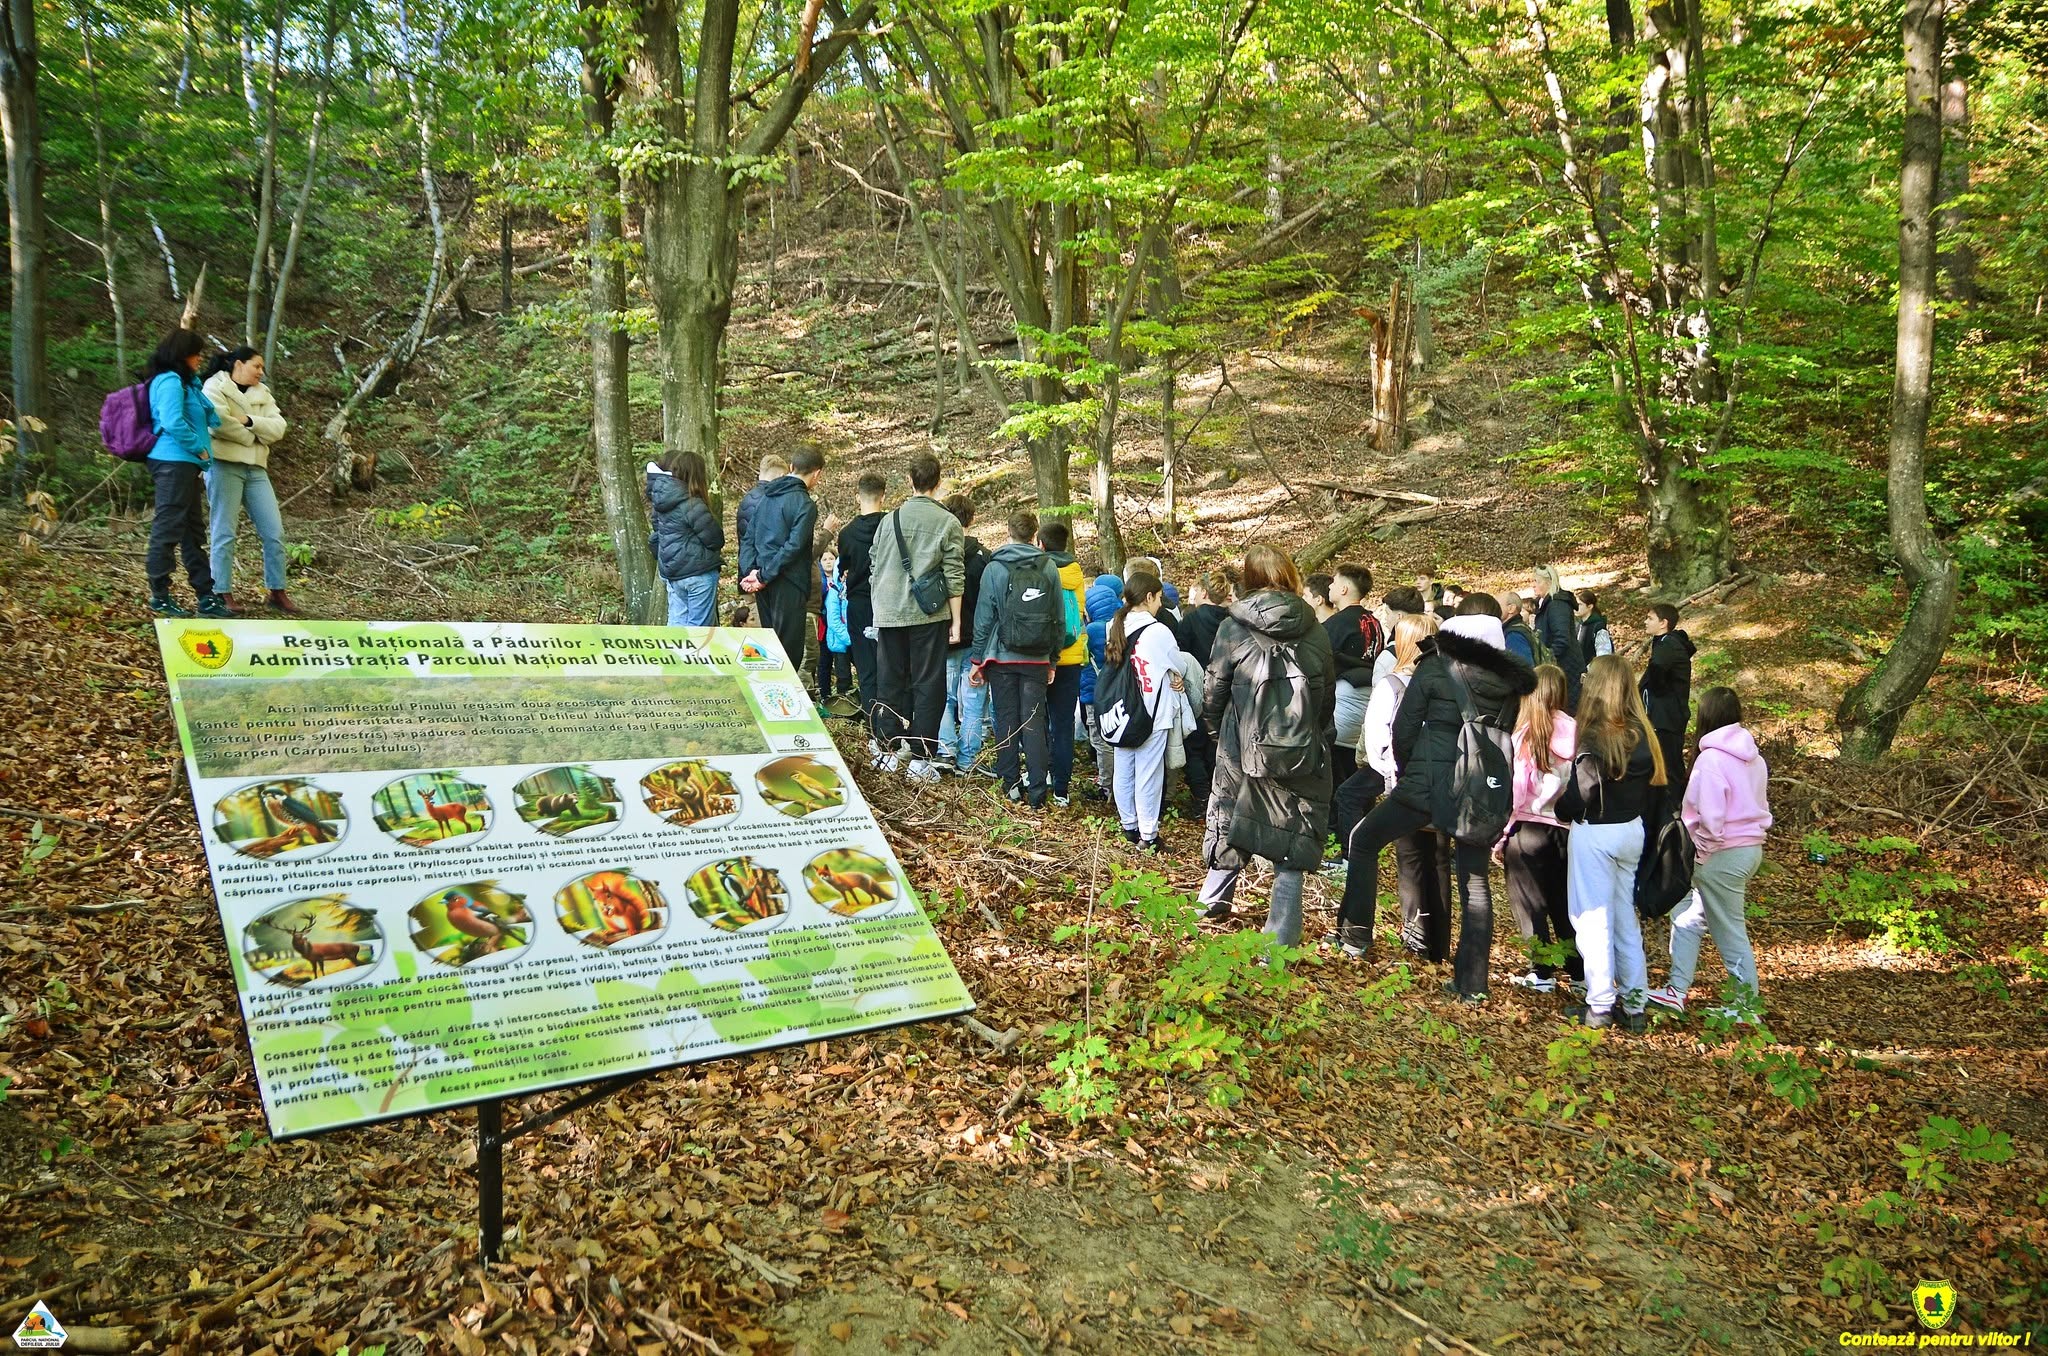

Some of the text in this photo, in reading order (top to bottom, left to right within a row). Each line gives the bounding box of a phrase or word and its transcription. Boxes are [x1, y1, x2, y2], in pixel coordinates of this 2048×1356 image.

[282, 635, 350, 652] Regia
[357, 636, 465, 652] Națională
[471, 639, 485, 648] a
[490, 636, 584, 648] Pădurilor
[600, 637, 697, 649] ROMSILVA
[246, 653, 731, 670] Administrația Parcului Național Defileul Jiului
[194, 720, 240, 730] tante
[245, 719, 297, 730] pentru
[302, 716, 413, 727] biodiversitatea
[416, 714, 475, 723] Parcului
[538, 711, 588, 720] Defileul
[701, 708, 721, 717] pin
[264, 704, 301, 714] Aici
[408, 701, 457, 711] Pinului
[555, 698, 627, 707] ecosisteme
[628, 697, 683, 706] distincte
[698, 696, 735, 705] impor-
[198, 734, 254, 744] vestru
[255, 733, 305, 744] (Pinus
[310, 730, 389, 742] sylvestris)
[469, 727, 487, 735] de
[490, 726, 544, 735] foioase,
[625, 722, 647, 731] fag
[648, 721, 689, 731] (Fagus
[223, 749, 279, 759] carpen
[283, 745, 358, 758] (Carpinus
[361, 742, 426, 753] betulus).
[220, 873, 278, 885] martius),
[280, 869, 334, 881] pitulicea
[407, 856, 484, 870] (Phylloscopus
[486, 851, 537, 862] trochilus)
[646, 840, 677, 849] (Falco
[678, 835, 726, 845] subbuteo).
[740, 831, 787, 840] asemenea,
[786, 828, 809, 836] locul
[829, 824, 862, 834] preferat
[273, 859, 289, 868] de
[293, 858, 312, 868] pin
[316, 854, 368, 864] silvestru
[371, 851, 389, 860] din
[475, 841, 513, 851] habitat
[516, 839, 550, 849] pentru
[553, 835, 607, 845] numeroase
[609, 831, 639, 841] specii
[287, 879, 353, 894] (Capreolus
[355, 873, 421, 886] capreolus),
[469, 867, 494, 877] (Sus
[496, 862, 534, 873] scrofa)
[547, 857, 596, 868] ocazional
[597, 856, 610, 864] de
[633, 851, 659, 860] bruni
[692, 845, 729, 855] arctos),
[729, 841, 777, 852] oferindu-le
[252, 1006, 285, 1018] ideal
[289, 1001, 332, 1014] pentru
[336, 994, 374, 1007] specii
[377, 989, 422, 1002] precum
[508, 972, 540, 982] verde
[542, 968, 577, 979] (Picus
[580, 961, 620, 972] viridis),
[659, 952, 690, 963] (Bubo
[691, 947, 722, 957] bubo),
[735, 942, 770, 951] cinteza
[770, 935, 812, 948] (Fringilla
[813, 929, 853, 940] coelebs).
[853, 924, 898, 935] Habitatele
[898, 920, 925, 929] create
[262, 1043, 346, 1062] Conservarea
[350, 1035, 398, 1048] acestor
[446, 1021, 490, 1033] diverse
[506, 1005, 588, 1024] interconectate
[590, 1001, 614, 1011] este
[666, 989, 700, 1001] pentru
[757, 971, 810, 985] echilibrului
[810, 966, 848, 977] ecologic
[849, 963, 859, 971] al
[859, 958, 895, 969] regiunii.
[273, 1091, 318, 1108] pentru
[412, 1068, 453, 1084] pentru
[532, 1049, 571, 1061] locale.
